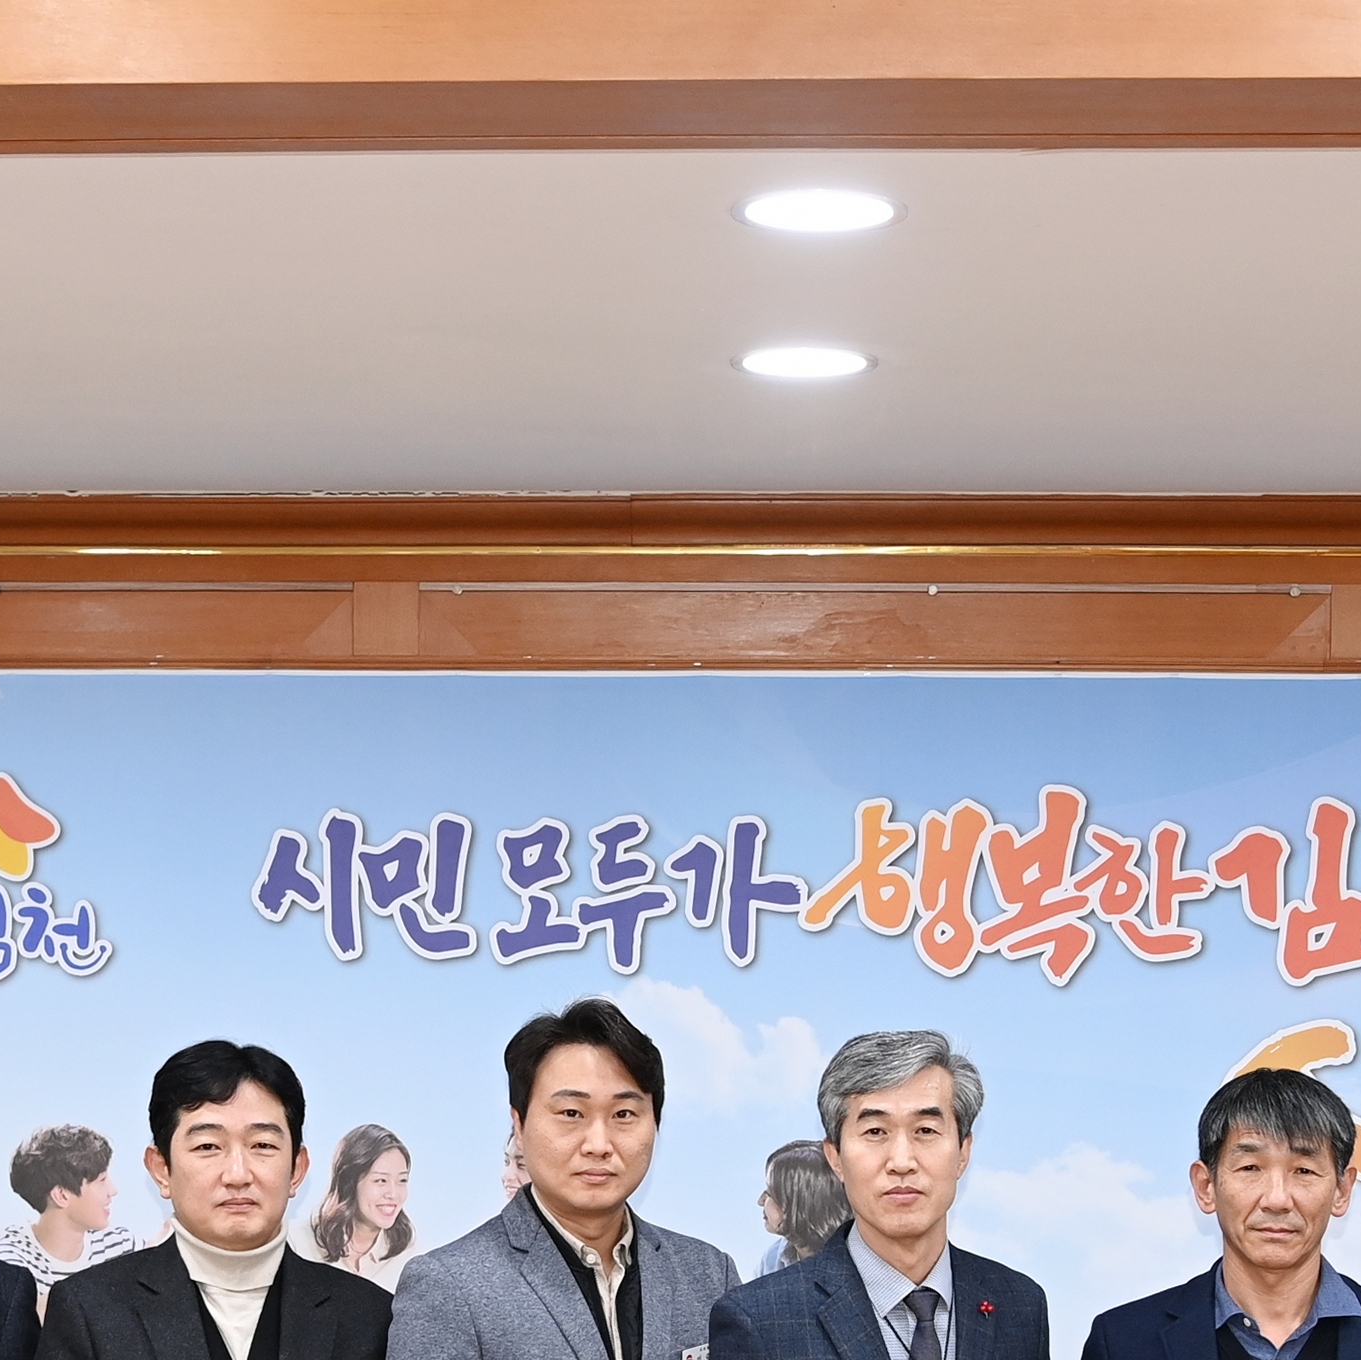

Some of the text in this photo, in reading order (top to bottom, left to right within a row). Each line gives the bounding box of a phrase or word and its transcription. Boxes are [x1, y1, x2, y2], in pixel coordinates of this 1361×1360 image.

[258, 815, 471, 954] 시민
[495, 820, 802, 967] 모두가
[803, 790, 1211, 981] 행복한
